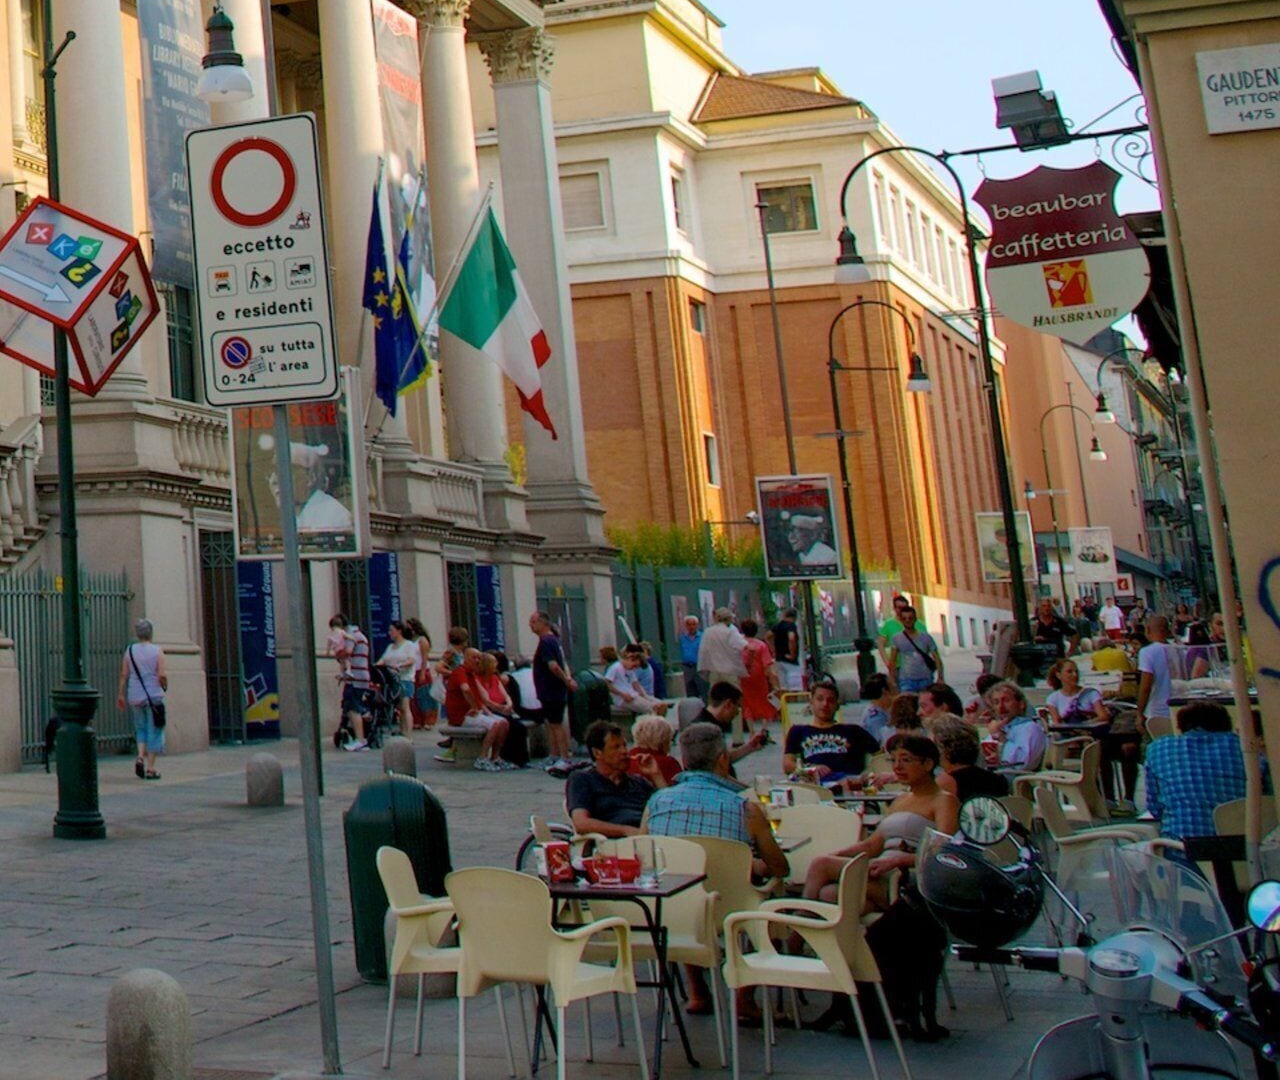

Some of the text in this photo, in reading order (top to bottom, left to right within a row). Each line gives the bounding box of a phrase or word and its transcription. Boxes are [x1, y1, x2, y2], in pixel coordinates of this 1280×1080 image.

[1207, 67, 1280, 92] GAUDEN
[1223, 91, 1280, 107] PITTOR
[1238, 108, 1275, 122] 1475
[991, 192, 1107, 220] beaubar
[223, 235, 295, 255] eccetto
[991, 223, 1127, 258] caffetteria
[216, 297, 313, 320] e residenti
[1033, 307, 1118, 327] HAUSBRANDT
[260, 340, 315, 353] su tutta
